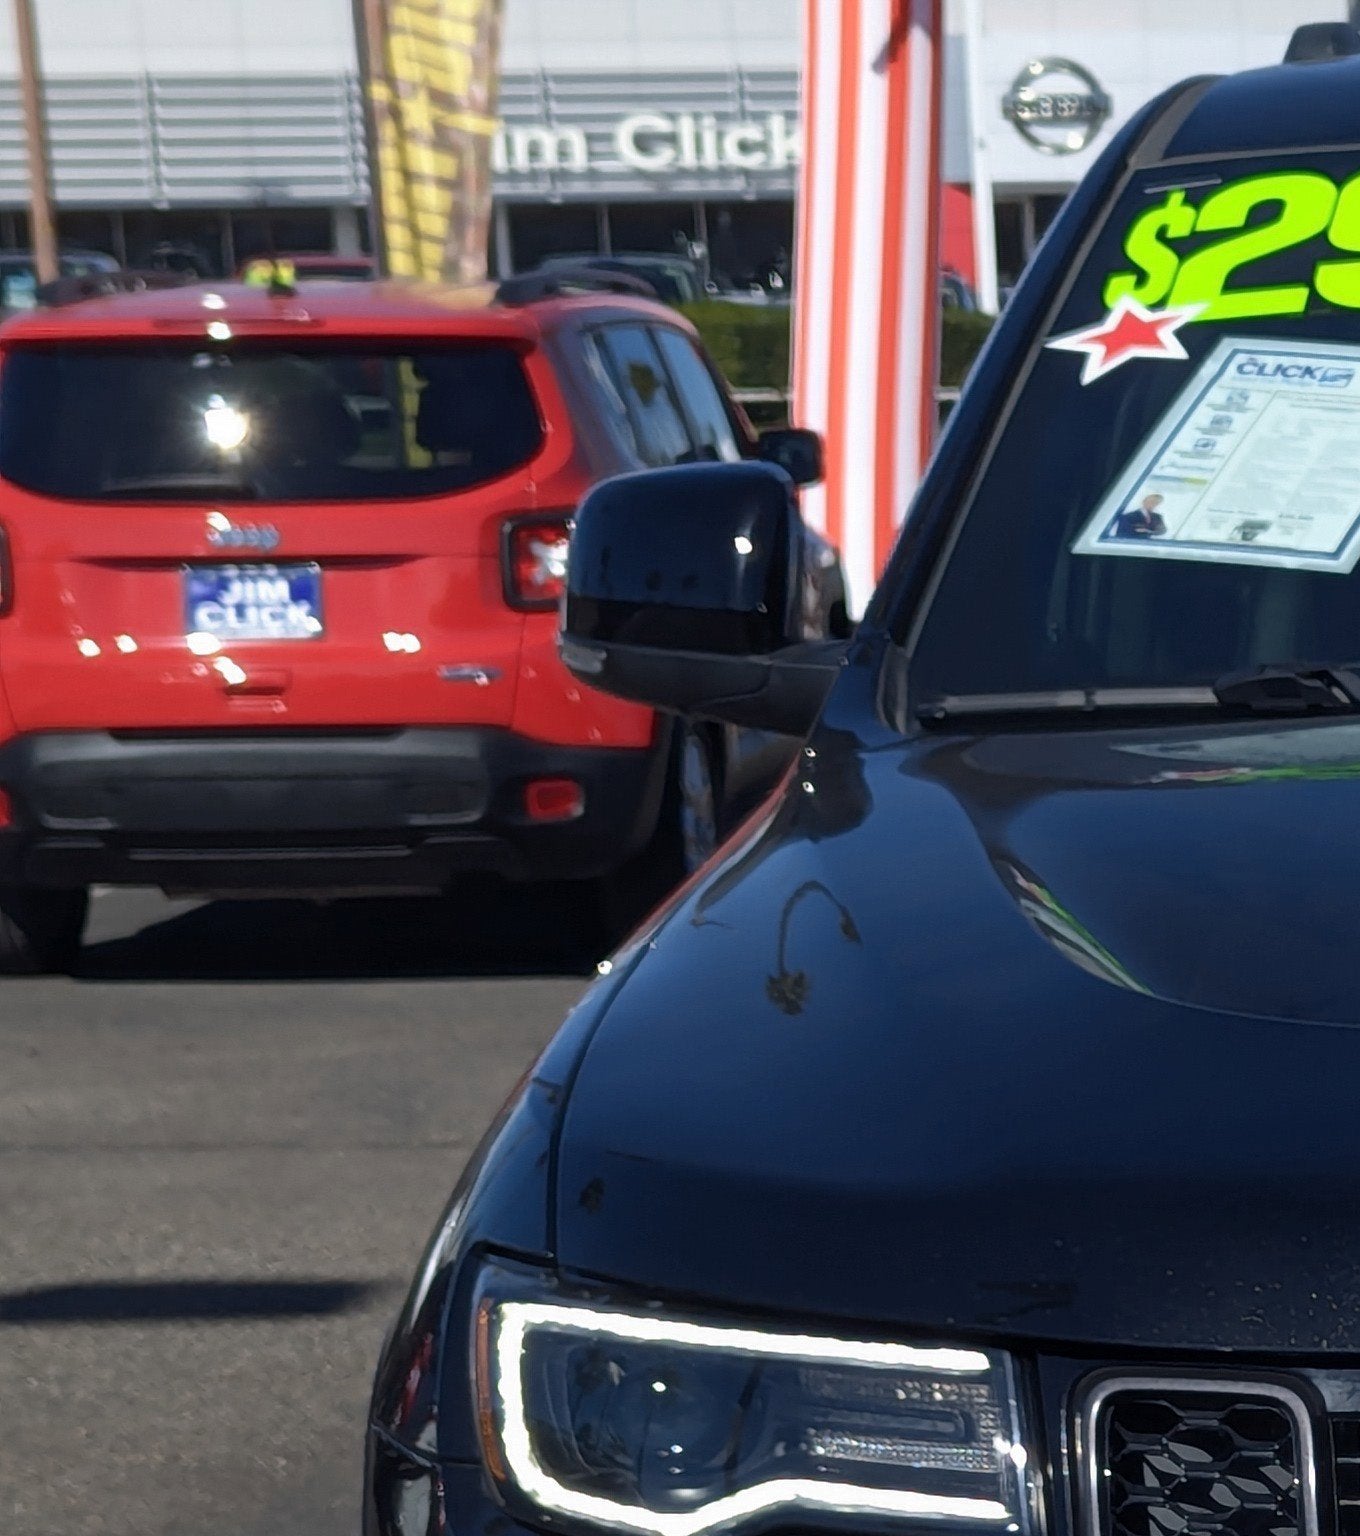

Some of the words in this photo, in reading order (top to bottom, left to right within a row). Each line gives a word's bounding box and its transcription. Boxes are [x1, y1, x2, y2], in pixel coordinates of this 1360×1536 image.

[492, 118, 588, 173] im
[217, 578, 291, 604] JIM
[194, 600, 320, 632] CLICK
